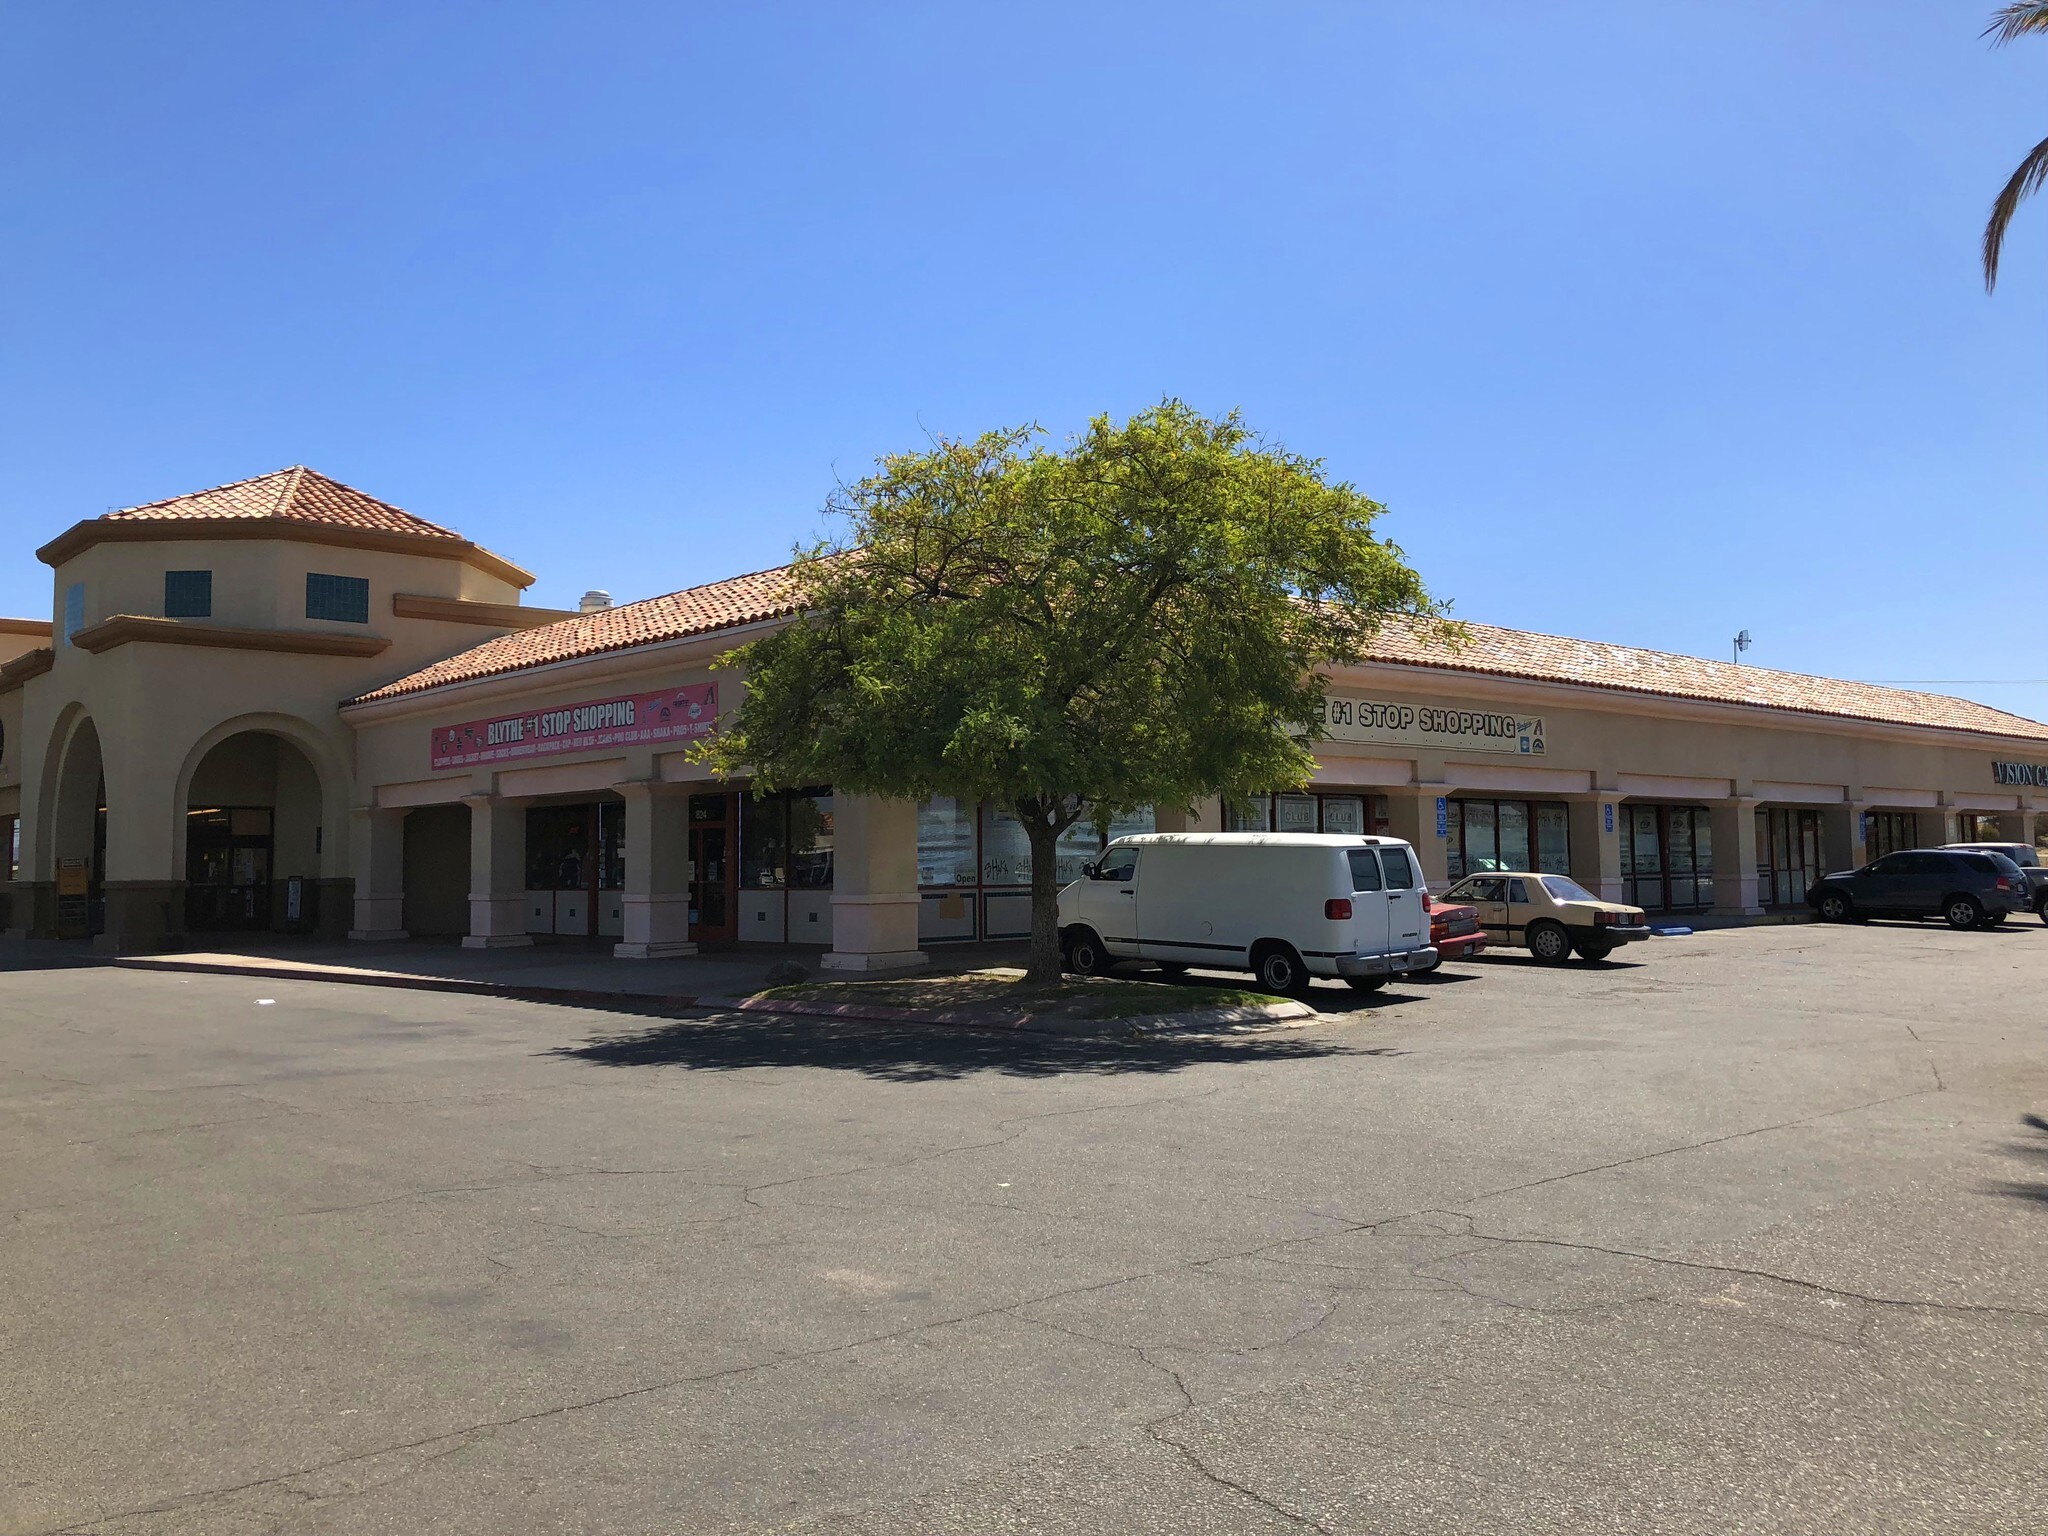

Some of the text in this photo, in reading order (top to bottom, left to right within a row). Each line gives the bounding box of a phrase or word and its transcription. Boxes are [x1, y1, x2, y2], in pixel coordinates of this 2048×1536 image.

[487, 717, 524, 746] BLYTHE
[526, 714, 539, 739] #1
[541, 710, 572, 738] STOP
[573, 700, 635, 736] SHOPPING
[1331, 701, 1352, 725] #1
[1359, 703, 1413, 729] STOP
[1419, 708, 1516, 738] SHOPPING
[1996, 762, 2033, 784] VISION
[695, 810, 707, 819] 824
[956, 874, 976, 884] Open
